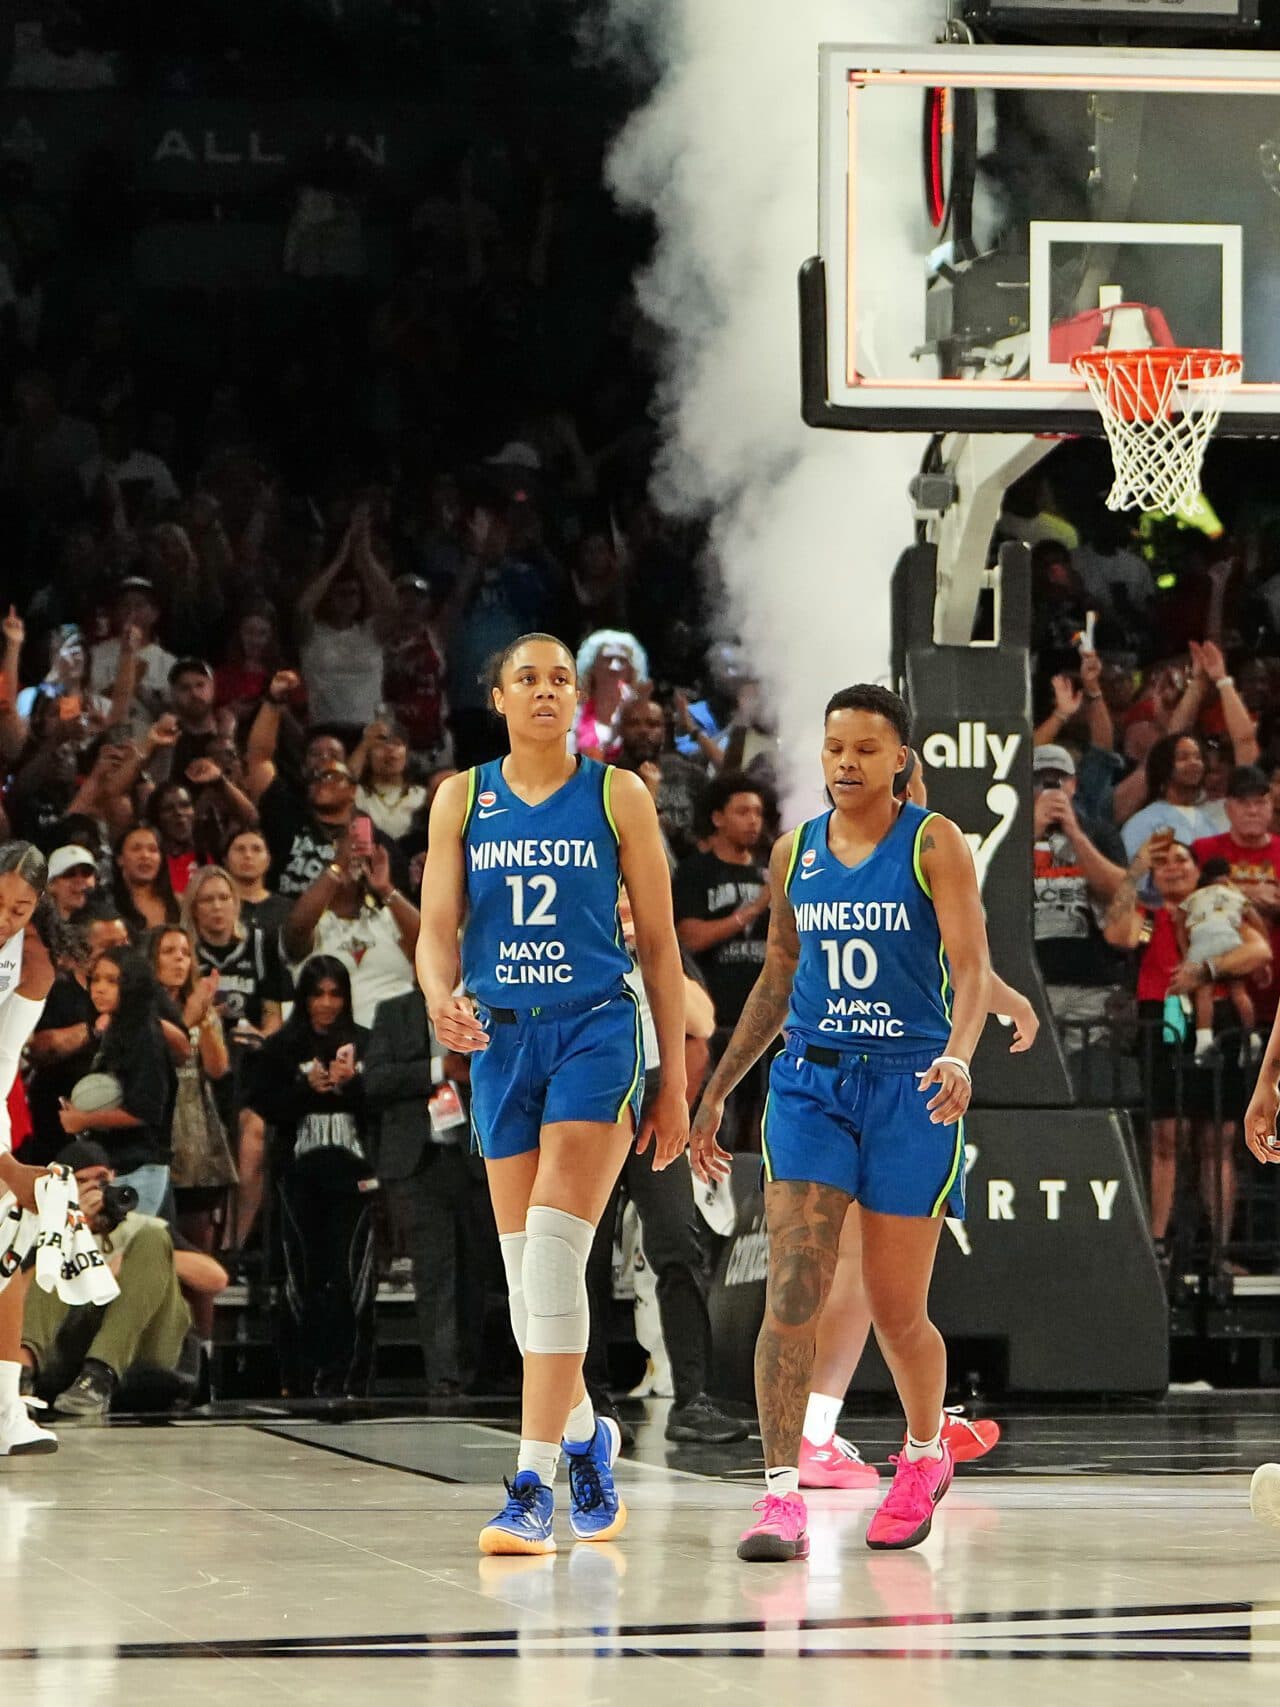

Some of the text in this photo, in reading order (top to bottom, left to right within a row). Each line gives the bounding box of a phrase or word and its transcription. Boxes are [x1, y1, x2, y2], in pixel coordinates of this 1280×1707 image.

[152, 128, 286, 165] ALL
[922, 722, 1021, 780] ally
[470, 839, 598, 872] MINNESOTA
[505, 874, 557, 926] 12
[793, 902, 911, 933] MINNESOTA
[500, 941, 566, 961] MAYO
[820, 938, 879, 991] 10
[495, 964, 574, 984] CLINIC
[826, 998, 891, 1017] MAYO
[818, 1018, 905, 1038] CLINIC
